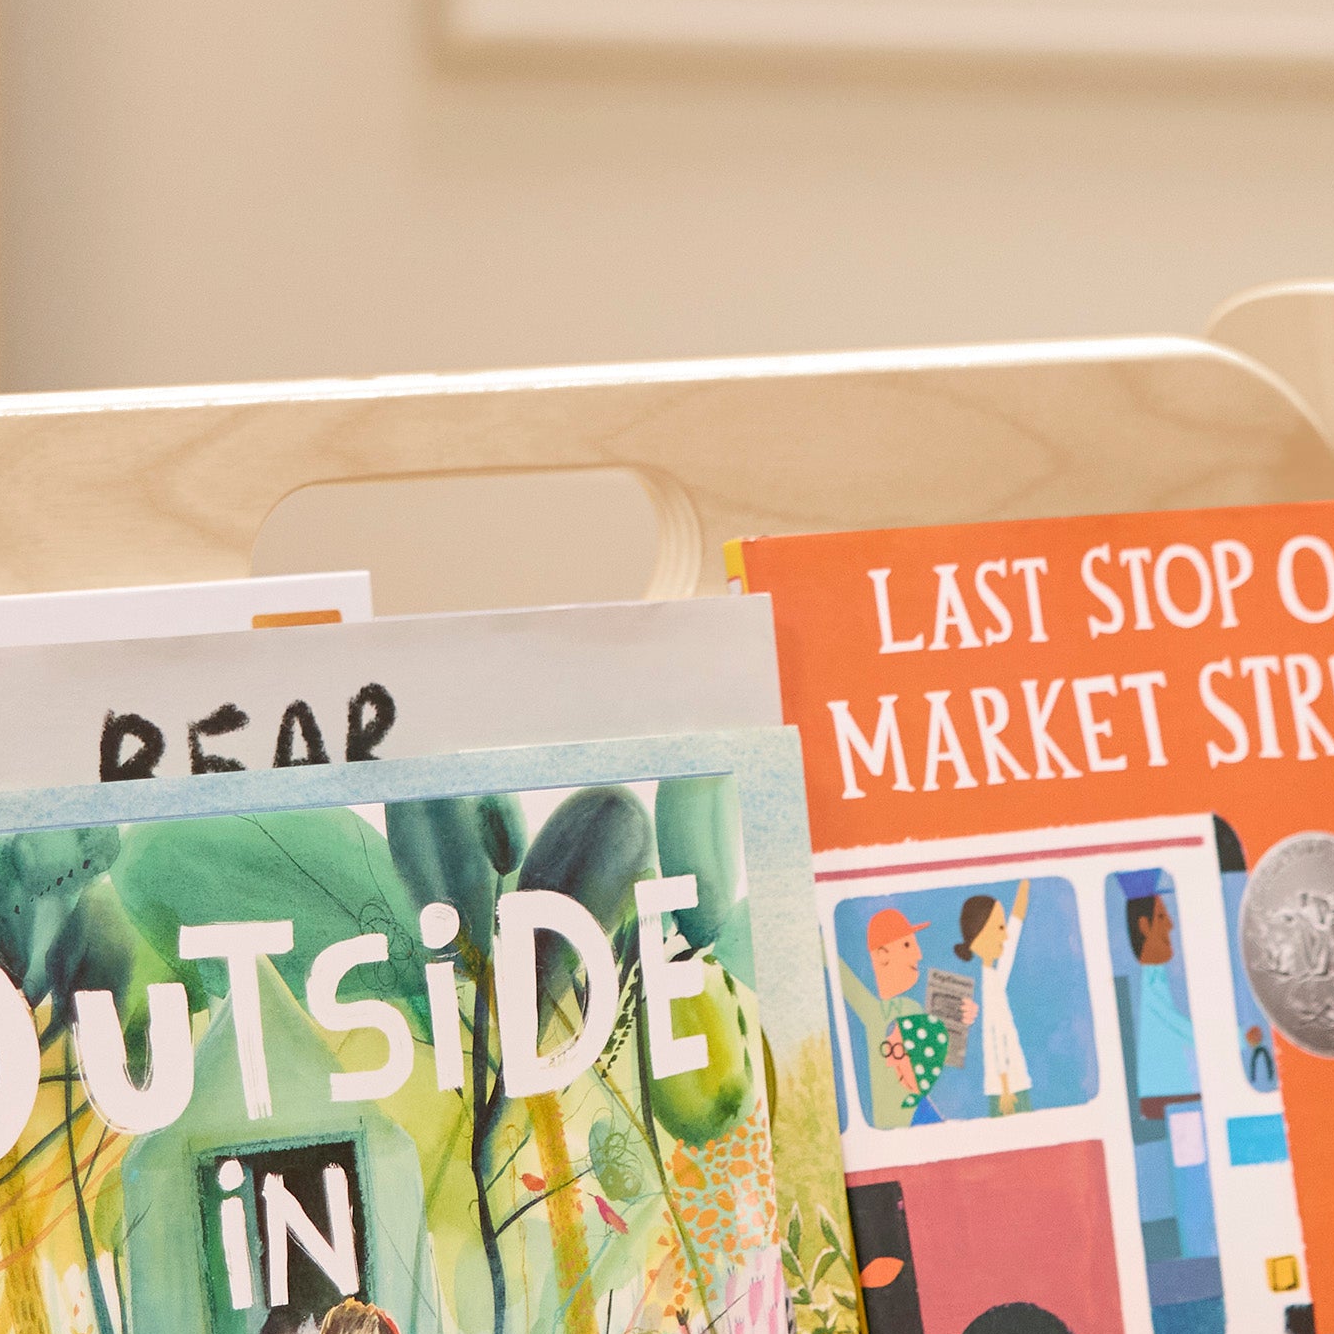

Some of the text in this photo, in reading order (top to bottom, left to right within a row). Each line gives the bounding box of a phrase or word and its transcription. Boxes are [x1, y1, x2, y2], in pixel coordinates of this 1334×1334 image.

[868, 557, 1049, 654] LAST
[1081, 540, 1254, 638] STOP
[826, 671, 1168, 800] MARKET
